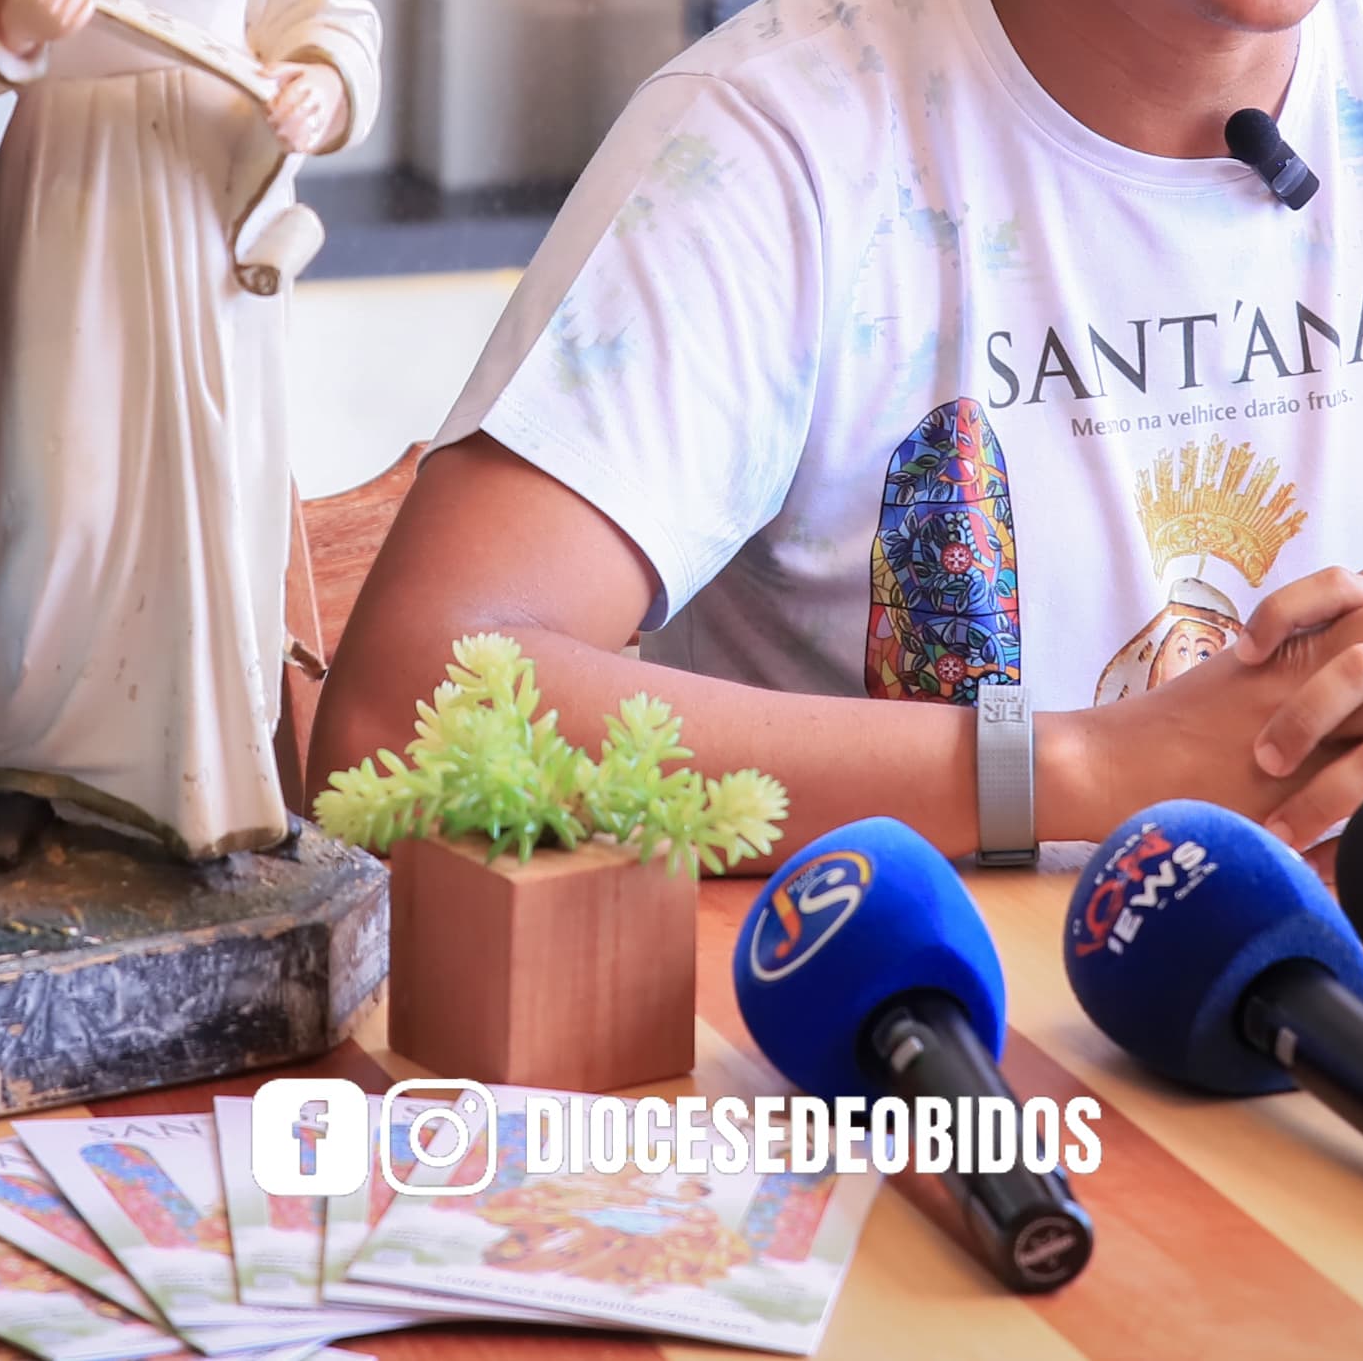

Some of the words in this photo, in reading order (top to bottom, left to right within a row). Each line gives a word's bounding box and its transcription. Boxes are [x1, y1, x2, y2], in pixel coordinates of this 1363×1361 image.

[1138, 414, 1162, 431] na
[1168, 403, 1237, 426] velhice
[1244, 395, 1301, 419] darão
